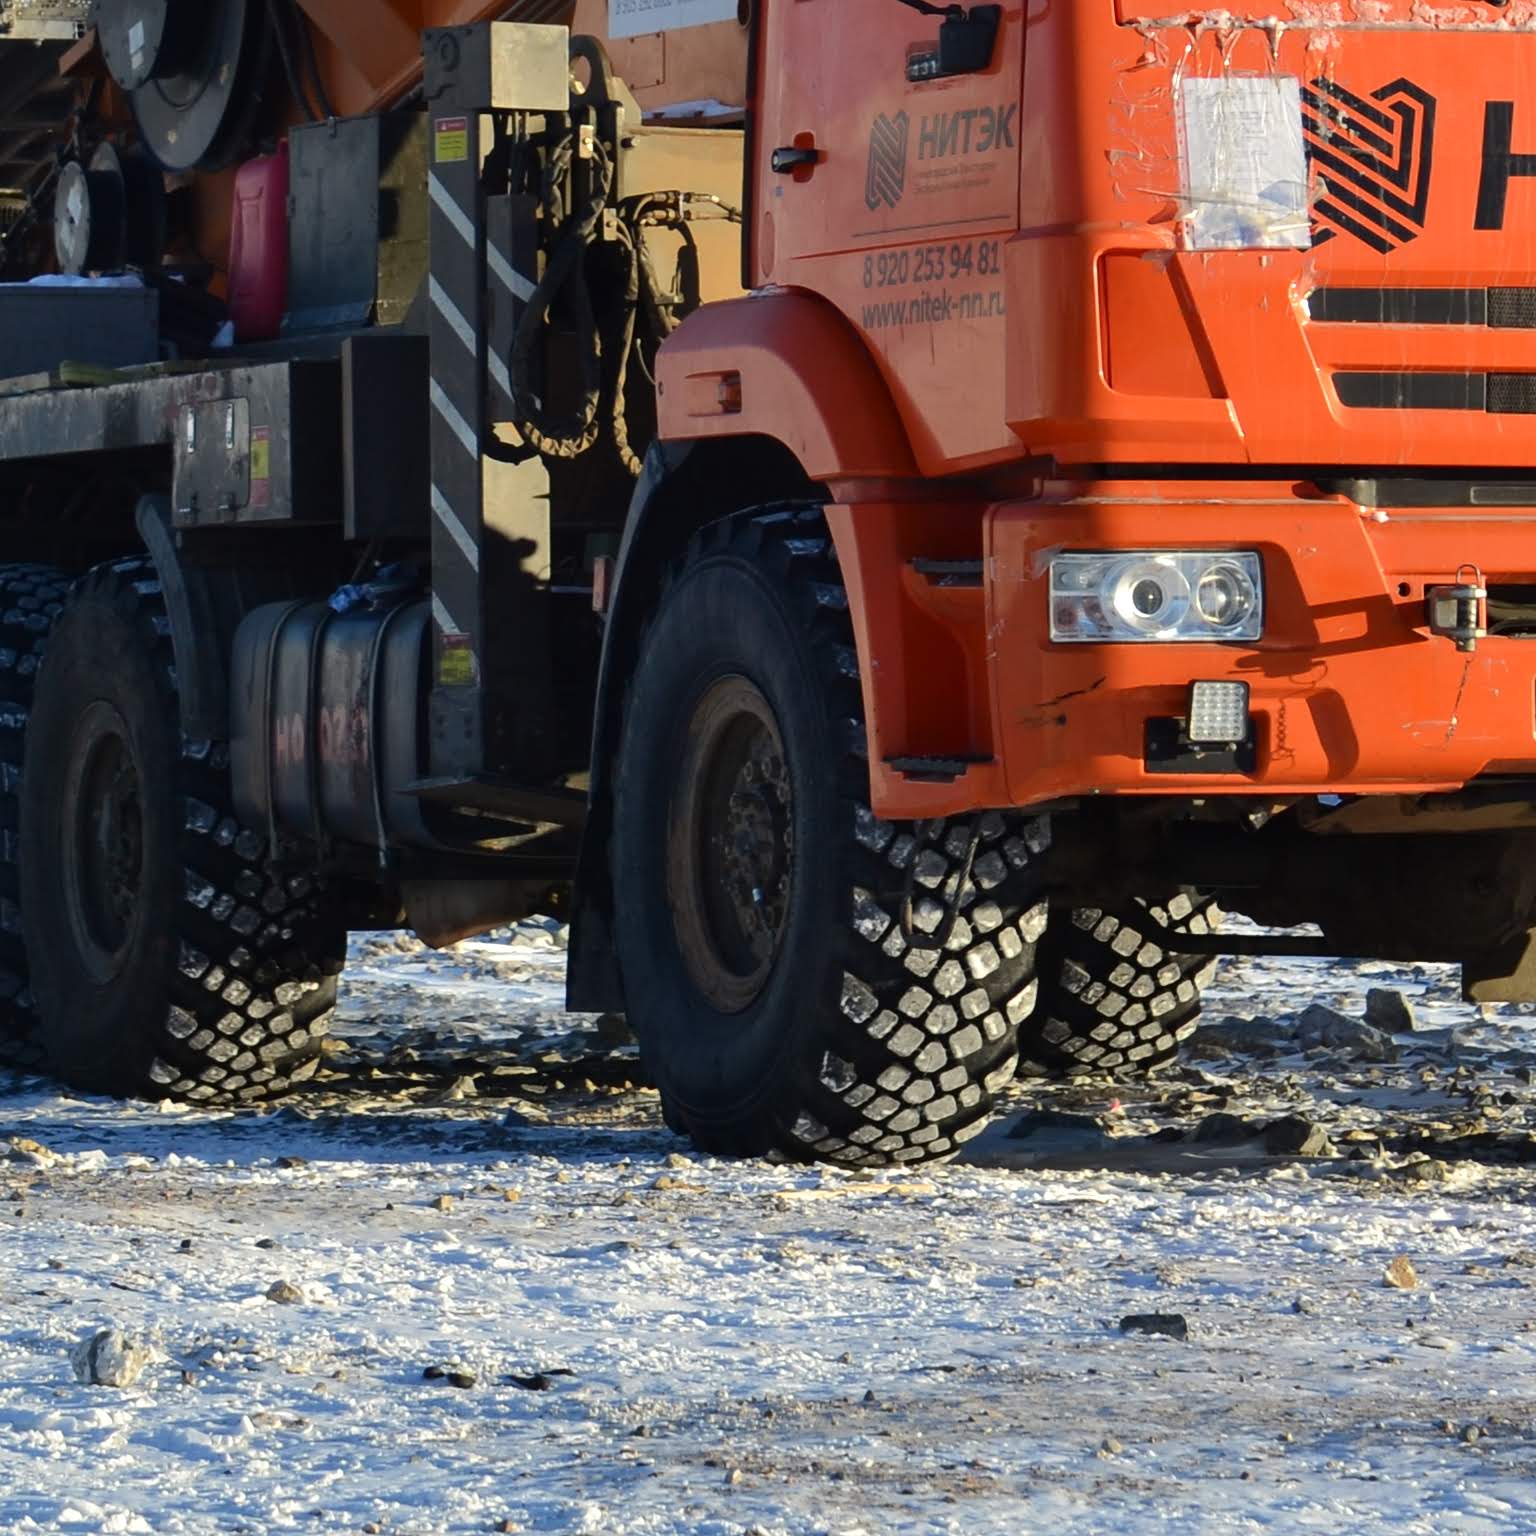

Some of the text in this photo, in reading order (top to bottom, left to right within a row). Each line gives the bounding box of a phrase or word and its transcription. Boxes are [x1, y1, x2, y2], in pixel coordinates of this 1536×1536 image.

[918, 102, 1018, 161] НИТЭК
[863, 239, 1002, 289] 8 920 253 94 81
[861, 287, 1007, 329] www.nitek-nn.ru
